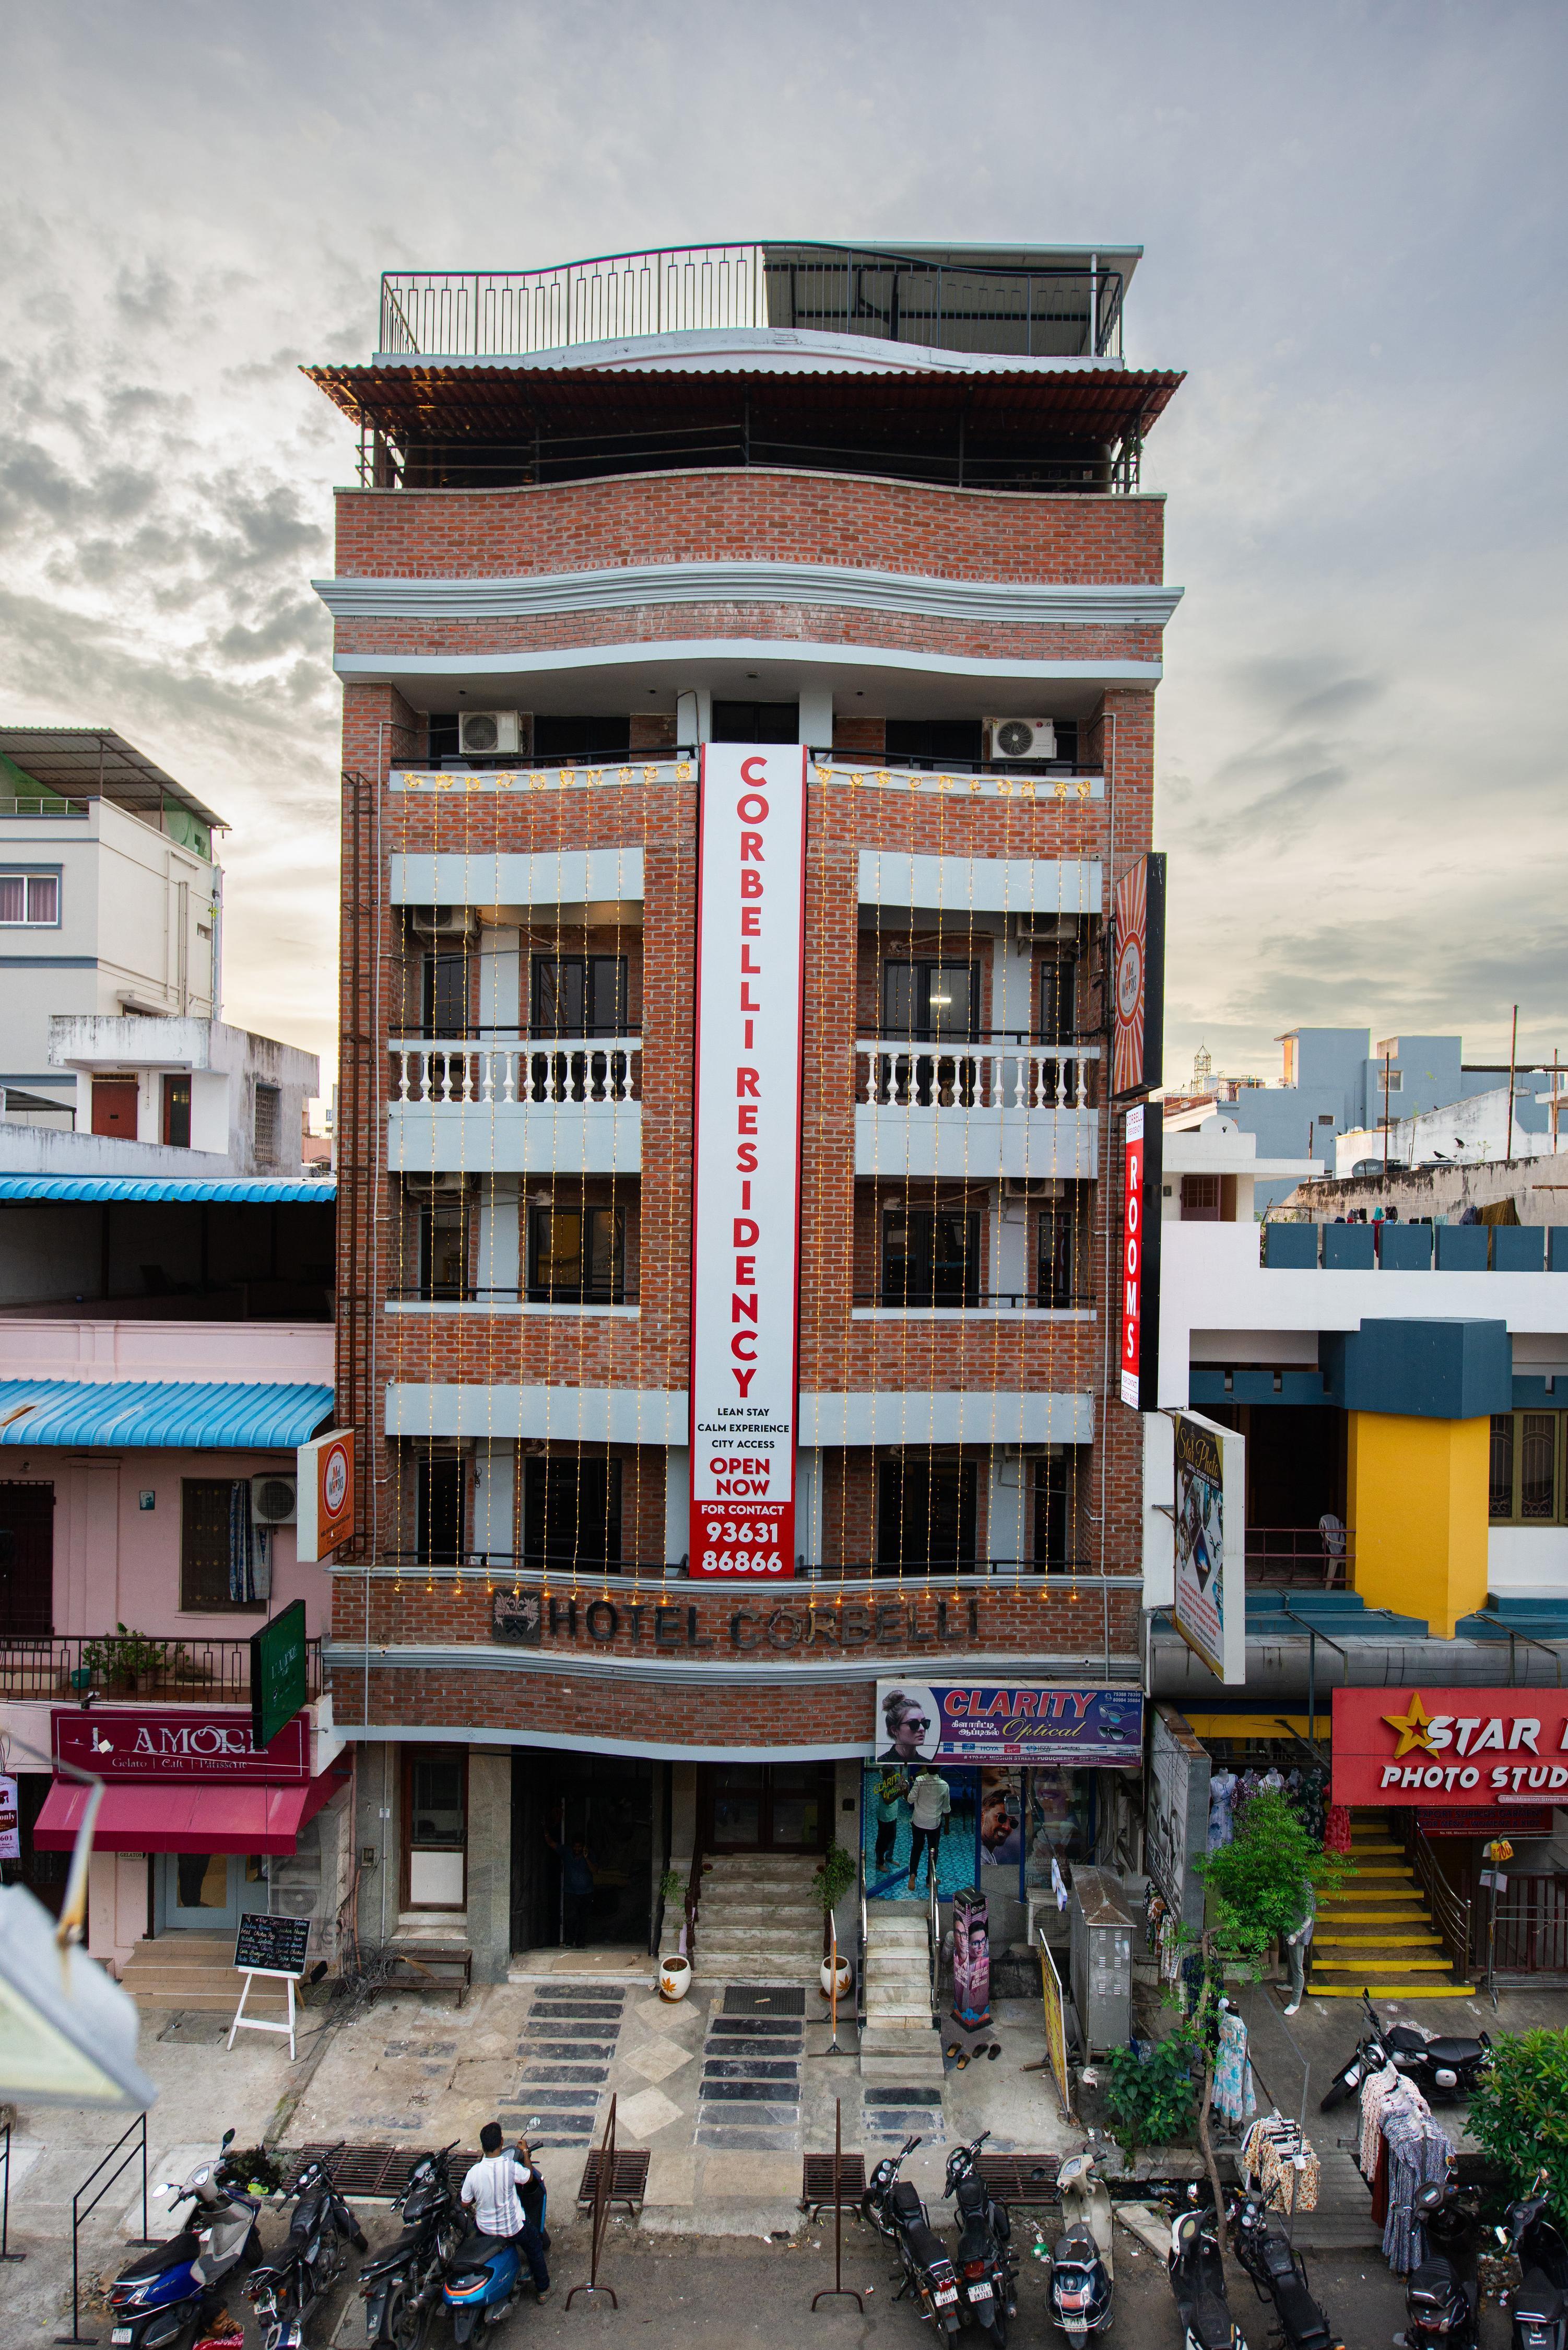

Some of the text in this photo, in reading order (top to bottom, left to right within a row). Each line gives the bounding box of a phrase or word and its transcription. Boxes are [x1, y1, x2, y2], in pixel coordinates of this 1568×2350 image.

[731, 756, 769, 1398] CORBELLI RESIDENCY
[1127, 1156, 1138, 1358] ROOMS
[729, 1424, 789, 1432] EXPERIENCE
[712, 1440, 775, 1449] CITY ACCESS
[1177, 1427, 1219, 1478] Star Photo
[710, 1457, 770, 1475] OPEN
[716, 1479, 770, 1496] NOW
[1196, 1469, 1207, 1480] STUDIO
[1210, 1477, 1219, 1488] VIDEO
[701, 1505, 784, 1515] FOR CONTACT
[706, 1522, 778, 1543] 93631
[702, 1550, 783, 1572] 86866
[549, 1596, 979, 1650] HOTEL CORBELLI
[944, 1690, 1097, 1718] CLARITY
[1002, 1718, 1087, 1743] Optical
[1424, 1716, 1541, 1757] STAR
[112, 1758, 147, 1768] Gelato
[1380, 1765, 1480, 1793] PHOTO
[1417, 1809, 1453, 1818] EXPORT
[1455, 1809, 1496, 1818] SURPLUS
[971, 1967, 984, 1977] TRUSTED
[972, 1978, 988, 1989] COUNTRIES
[974, 2285, 986, 2293] PY01
